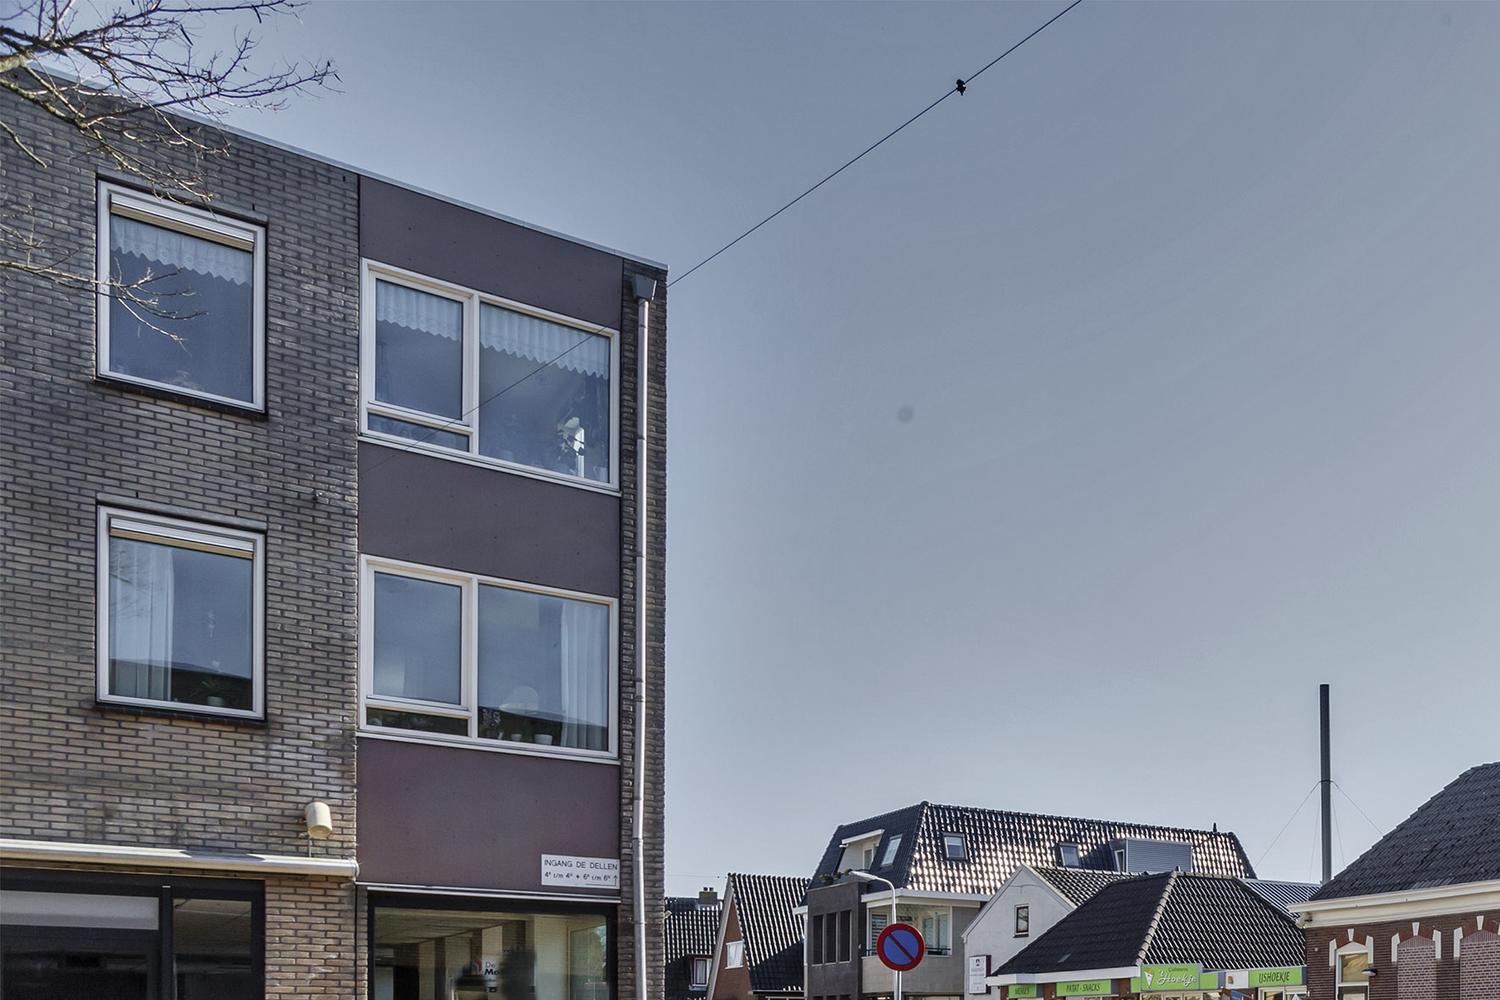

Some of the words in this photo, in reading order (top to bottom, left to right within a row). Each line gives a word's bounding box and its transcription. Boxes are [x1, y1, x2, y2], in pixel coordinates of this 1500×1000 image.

[544, 859, 573, 868] INGANG
[589, 862, 618, 870] DELLEN
[1082, 983, 1101, 992] SNACKS
